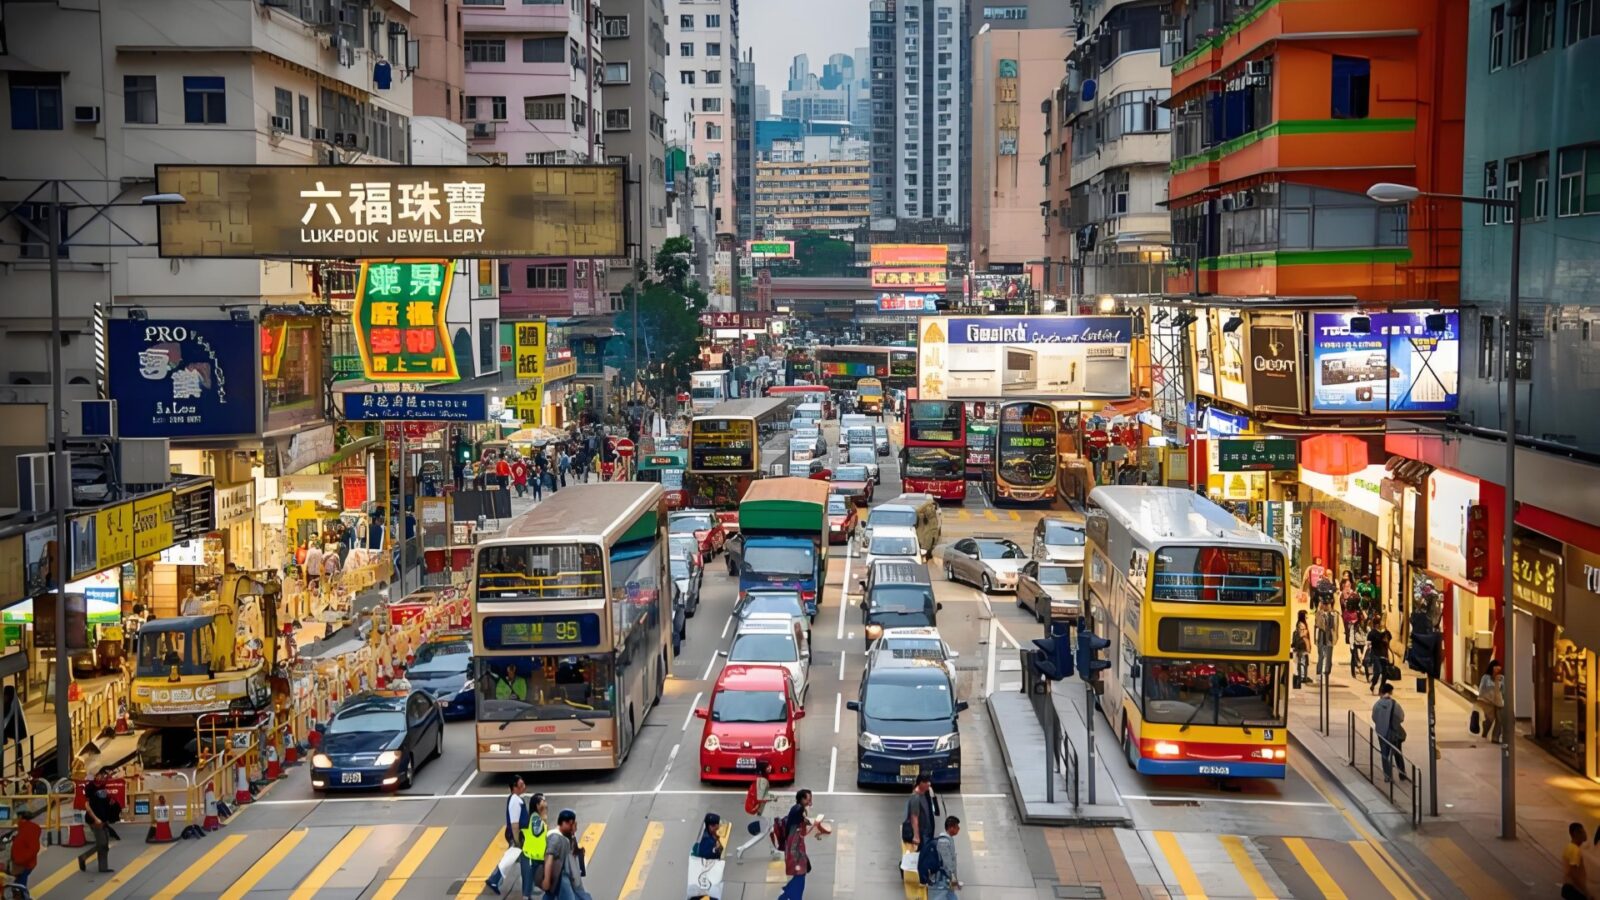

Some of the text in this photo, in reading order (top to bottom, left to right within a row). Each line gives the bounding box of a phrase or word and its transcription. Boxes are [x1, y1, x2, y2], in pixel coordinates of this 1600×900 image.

[300, 181, 486, 226] 六福珠寶
[556, 621, 578, 640] 95
